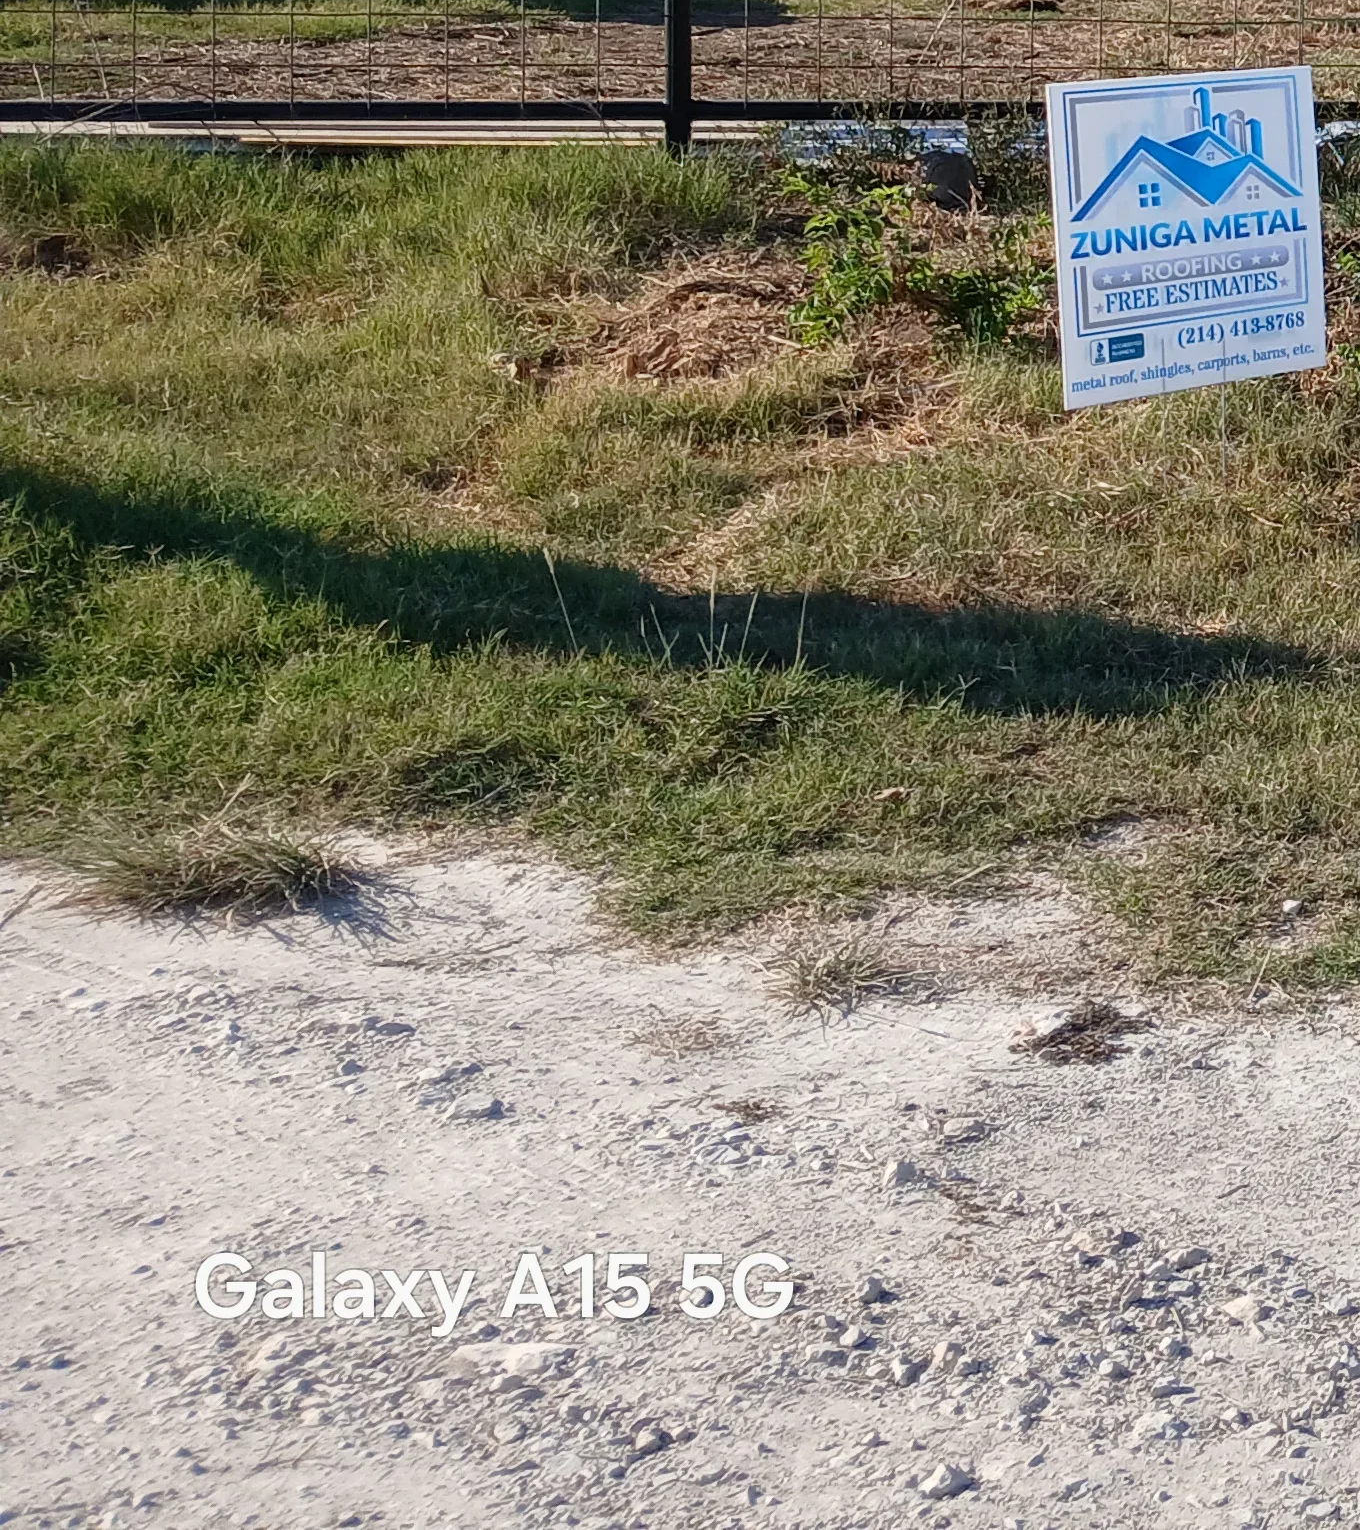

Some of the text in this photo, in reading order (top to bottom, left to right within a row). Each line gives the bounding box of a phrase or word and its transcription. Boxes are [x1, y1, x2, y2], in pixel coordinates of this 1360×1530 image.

[1070, 207, 1307, 259] ZUNIGA METAL
[1141, 252, 1242, 283] ROOFING
[1104, 270, 1278, 314] FREE ESTIMATES
[1177, 311, 1305, 349] (214) 413-8768
[1071, 341, 1315, 392] metal roof, shingles, carports, barns, etc.
